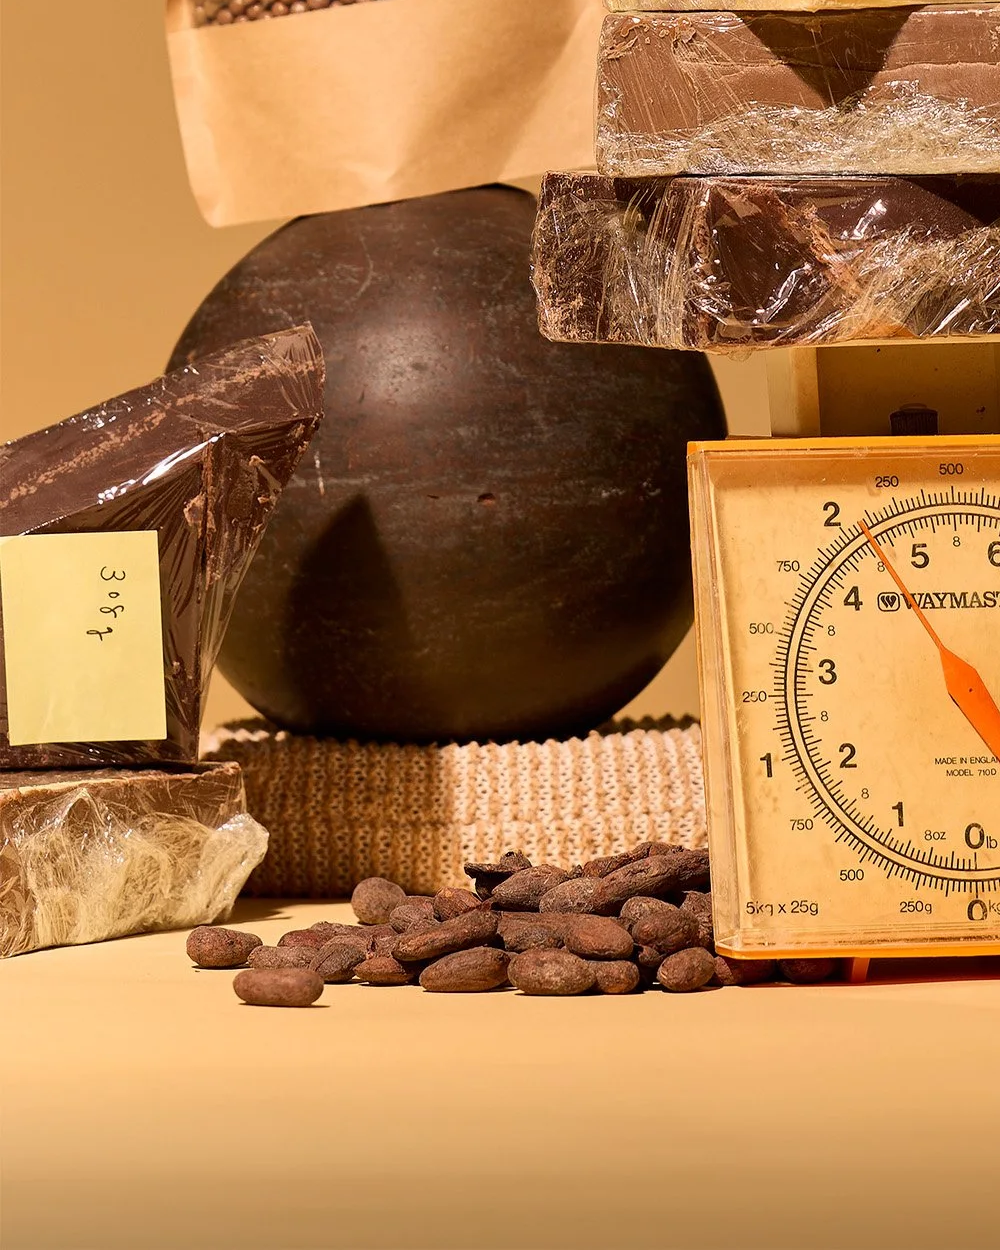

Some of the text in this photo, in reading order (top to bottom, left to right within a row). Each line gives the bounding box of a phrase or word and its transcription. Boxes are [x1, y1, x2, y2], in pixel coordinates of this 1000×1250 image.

[939, 463, 964, 475] 500
[875, 476, 899, 488] 250
[823, 502, 842, 527] 2
[952, 536, 961, 547] 8
[911, 543, 930, 569] 5
[776, 560, 801, 572] 750
[877, 561, 886, 573] 8
[843, 586, 863, 611] 4
[749, 622, 774, 634] 500
[827, 625, 836, 637] 8
[818, 659, 837, 685] 3
[742, 691, 767, 703] 250
[820, 711, 829, 722] 8
[838, 743, 858, 769] 2
[934, 756, 957, 765] MADE
[960, 756, 967, 764] IN
[759, 753, 773, 778] 1
[946, 768, 997, 777] MODEL 710D
[861, 788, 870, 800] 8
[891, 801, 905, 827] 1
[789, 819, 814, 831] 750
[924, 829, 947, 841] 8oz
[839, 869, 865, 882] 500
[746, 900, 819, 917] 5kg x 25g
[899, 901, 933, 915] 250g
